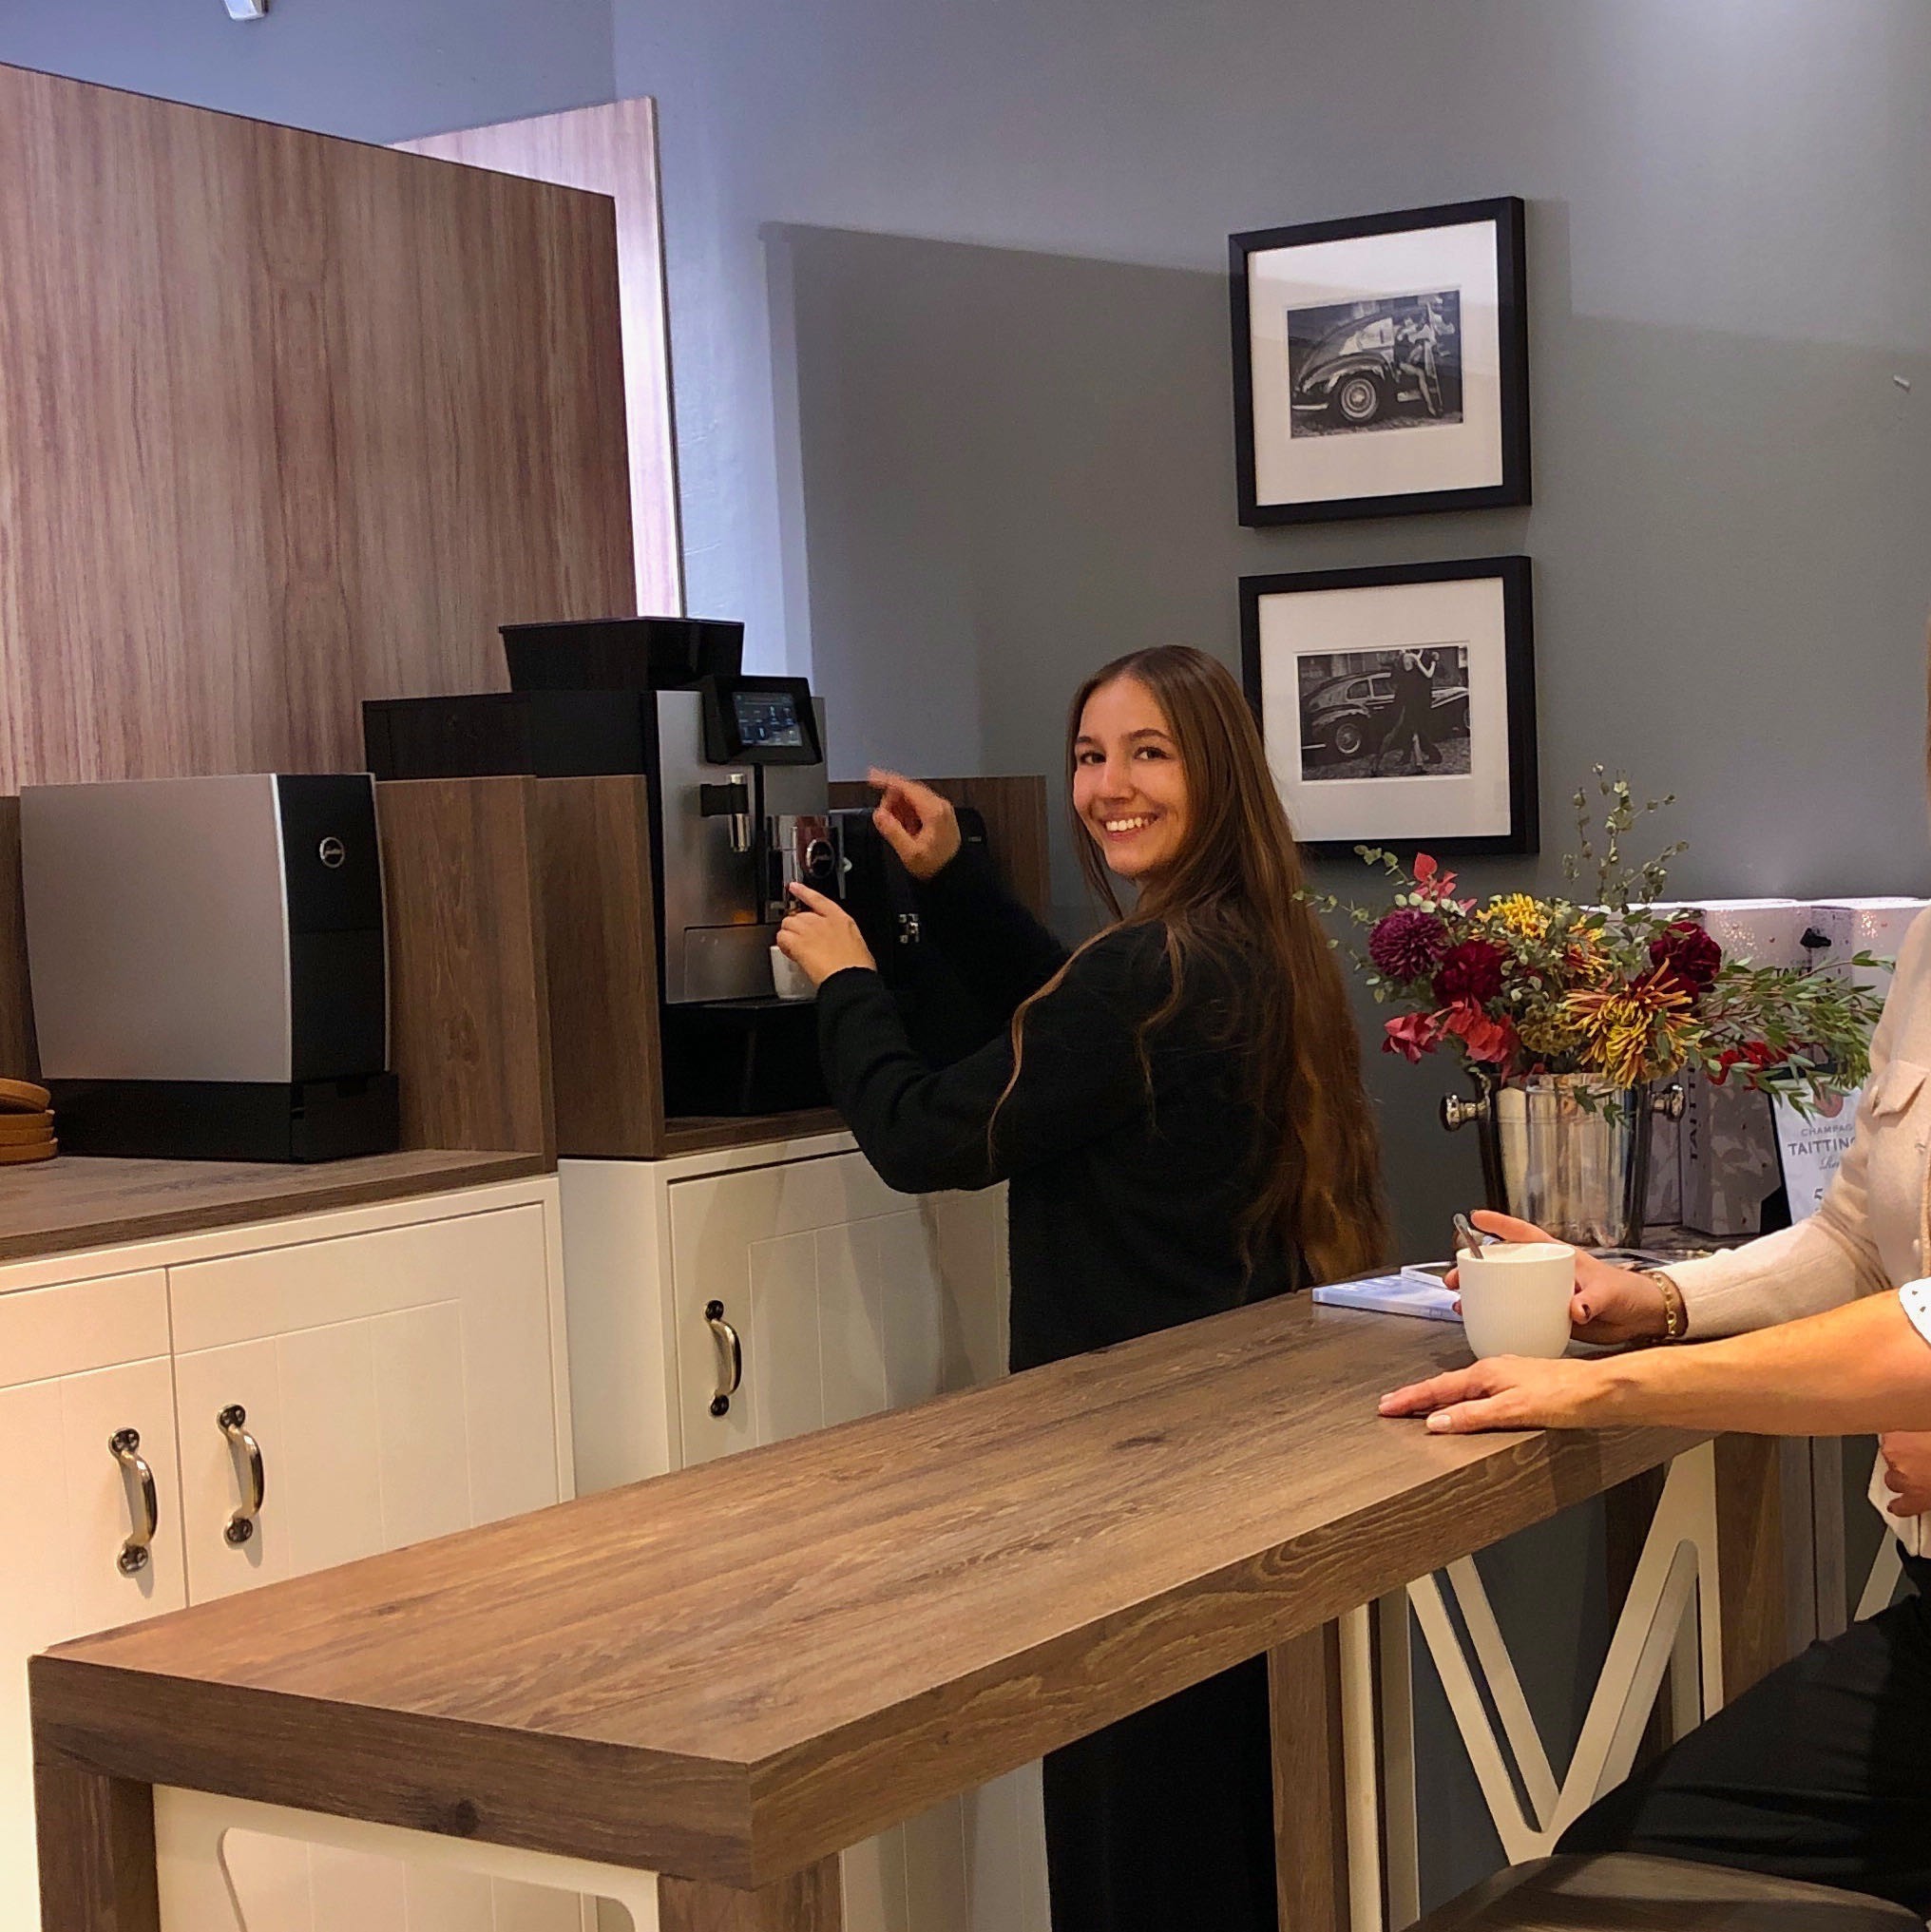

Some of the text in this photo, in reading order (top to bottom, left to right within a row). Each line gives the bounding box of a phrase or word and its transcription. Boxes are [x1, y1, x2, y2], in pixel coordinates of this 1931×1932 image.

[1688, 1067, 1698, 1165] TAITTI
[1801, 1123, 1853, 1137] CHAMPAG
[1788, 1137, 1856, 1157] TAITTIN
